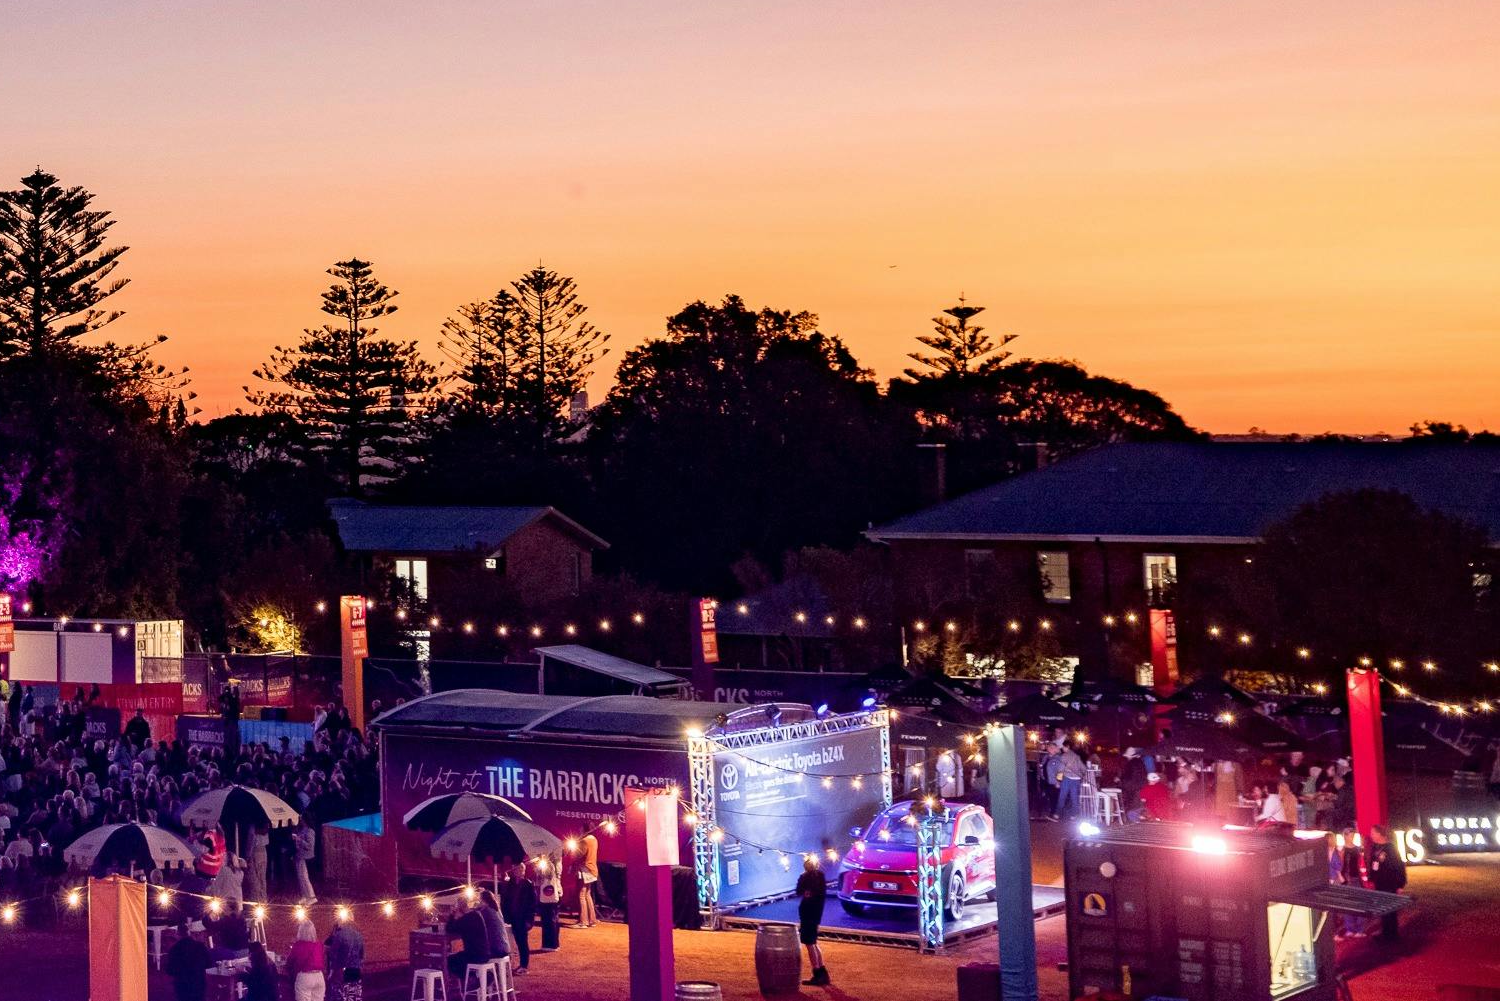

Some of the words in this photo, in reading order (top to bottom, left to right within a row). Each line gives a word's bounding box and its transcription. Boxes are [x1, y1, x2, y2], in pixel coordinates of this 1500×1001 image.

[53, 622, 65, 631] BAR
[182, 683, 202, 696] ACKS
[754, 689, 784, 697] NORTH
[793, 750, 822, 772] Toyota
[822, 745, 845, 764] bZ4X
[402, 762, 461, 796] Night
[461, 769, 483, 790] at
[485, 765, 525, 799] THE
[644, 776, 677, 785] NORTH
[720, 790, 741, 802] TOYOTA
[555, 809, 600, 820] PRESENTED
[1429, 817, 1492, 830] VODKA
[1437, 833, 1486, 846] SODA
